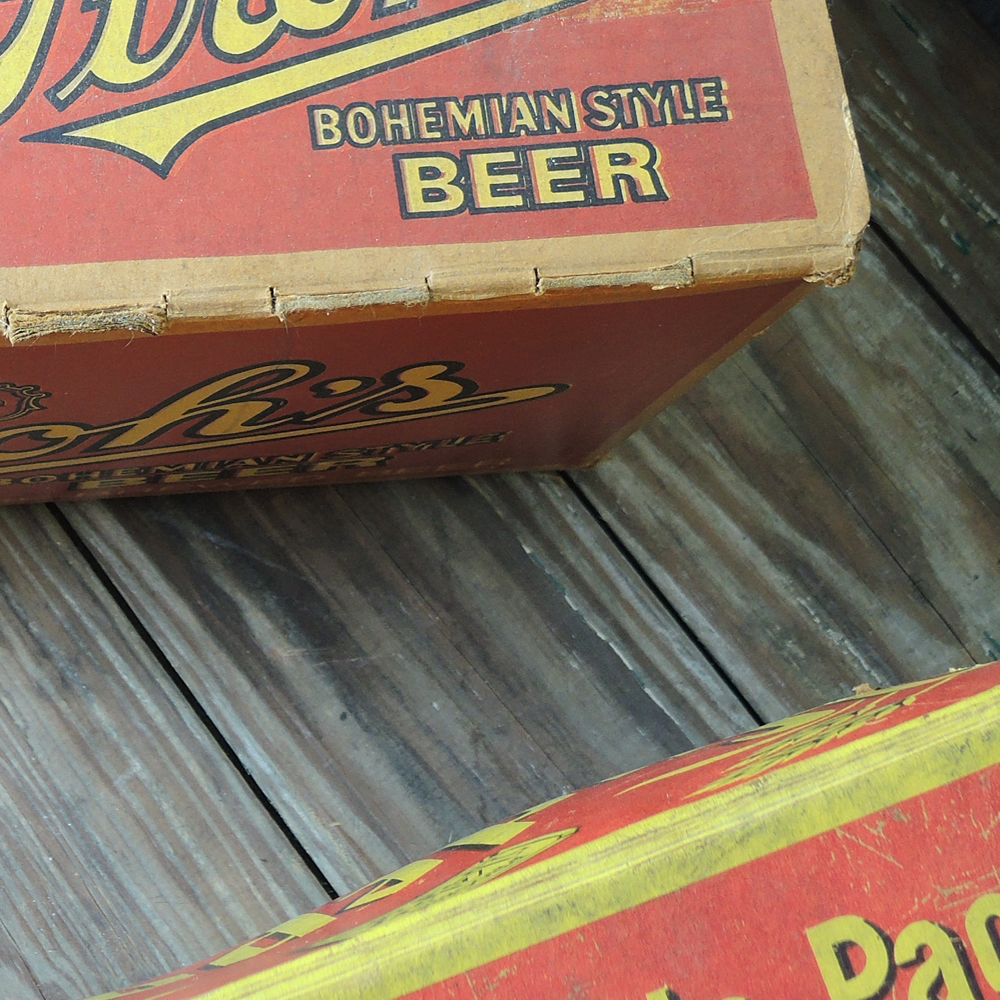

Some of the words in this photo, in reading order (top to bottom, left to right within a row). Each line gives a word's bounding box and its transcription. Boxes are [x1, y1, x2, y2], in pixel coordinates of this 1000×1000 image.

[307, 85, 580, 151] BOHEMIAN
[582, 75, 736, 132] STYLE
[393, 137, 672, 220] BEER
[68, 455, 396, 491] BEER
